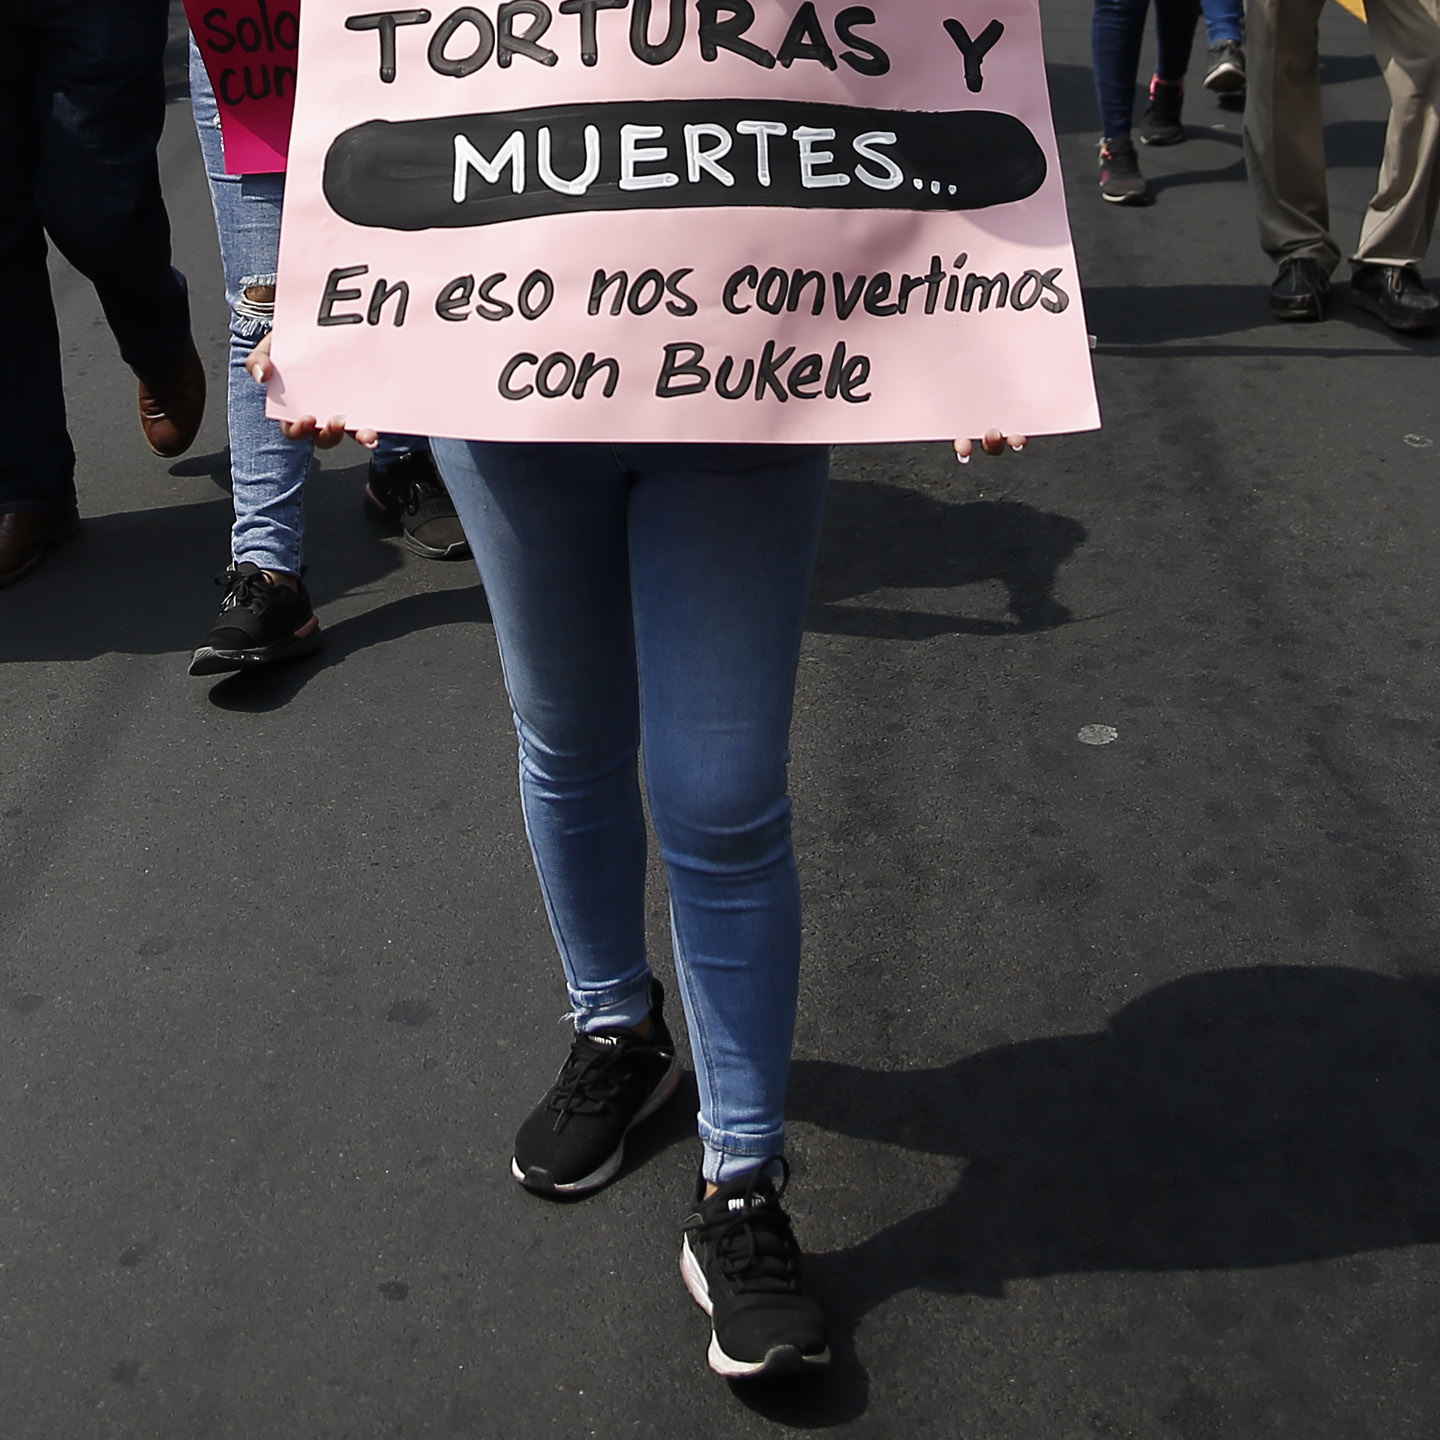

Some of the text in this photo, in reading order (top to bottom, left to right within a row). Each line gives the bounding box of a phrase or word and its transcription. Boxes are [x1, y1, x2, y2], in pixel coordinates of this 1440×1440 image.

[942, 16, 1005, 93] Y
[452, 120, 959, 205] MUERTES...
[315, 252, 1071, 328] En eso nos convertimos
[497, 350, 621, 401] con
